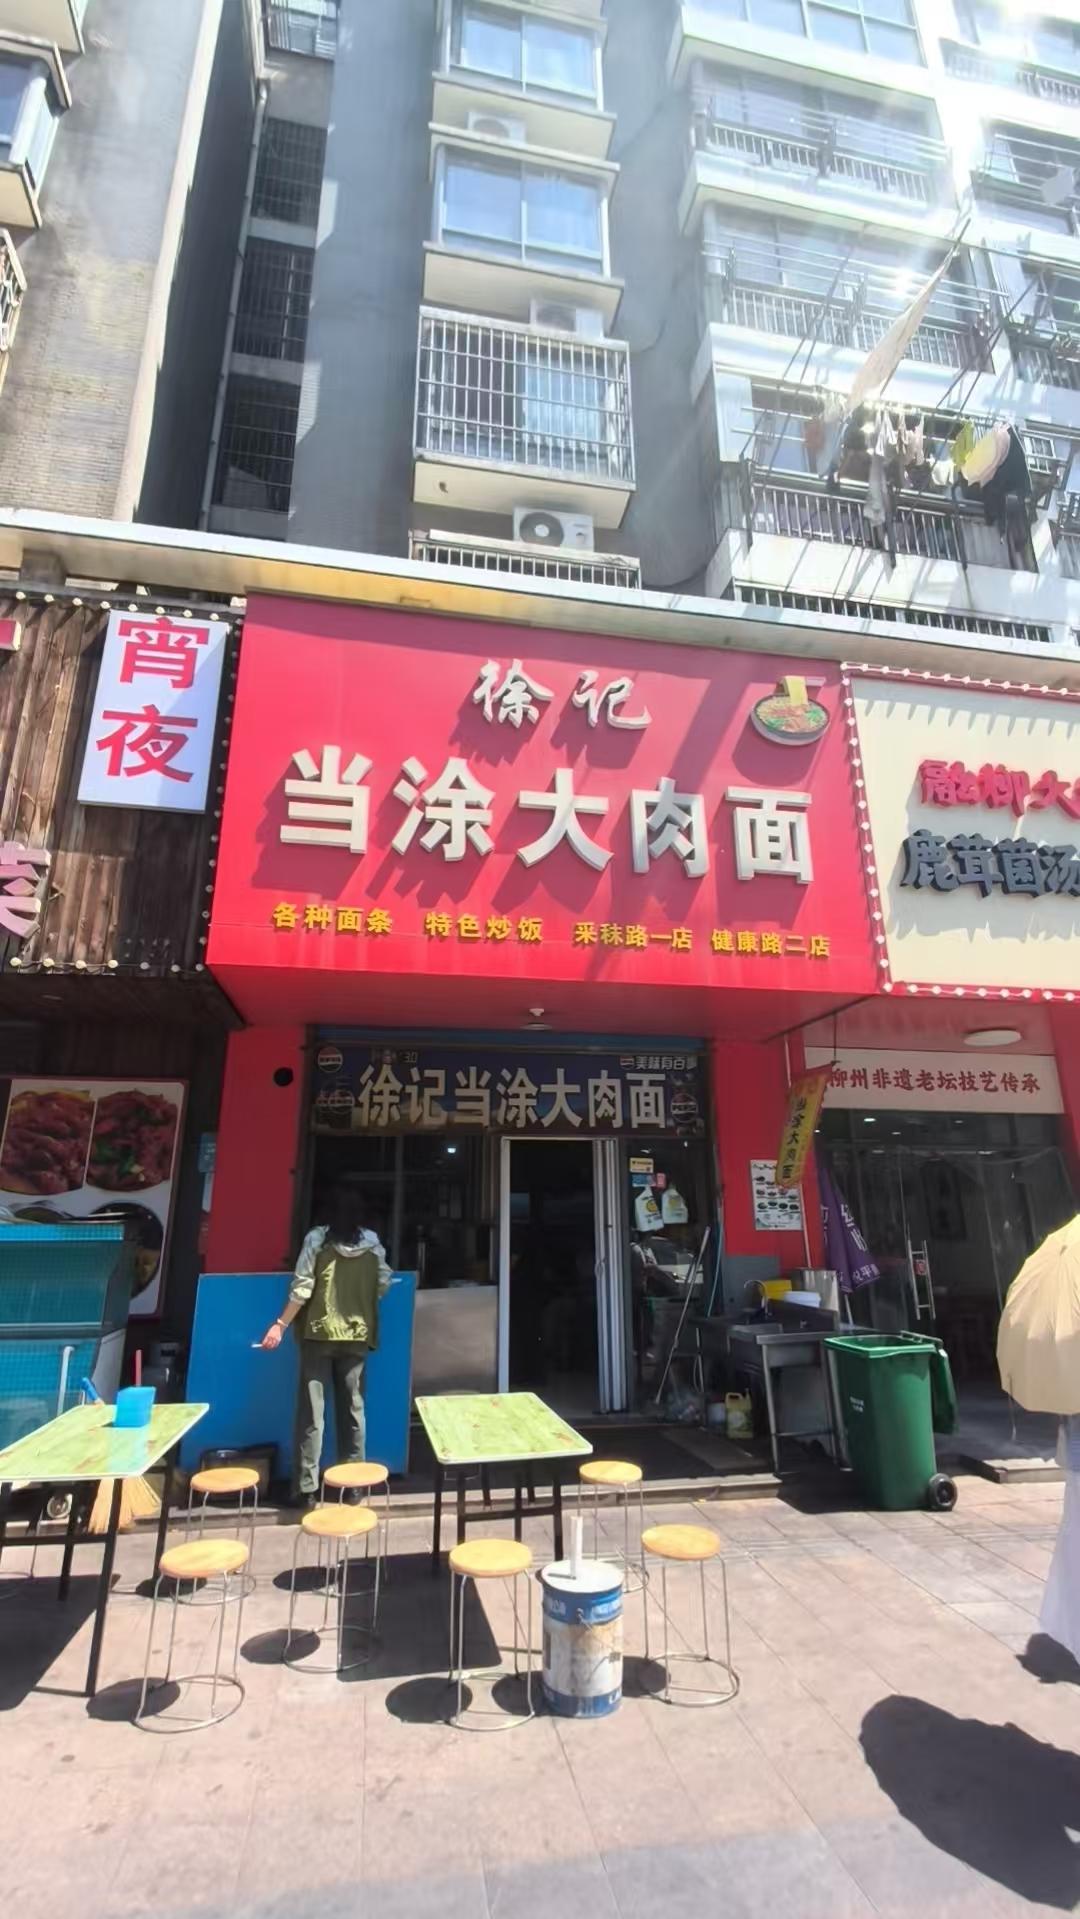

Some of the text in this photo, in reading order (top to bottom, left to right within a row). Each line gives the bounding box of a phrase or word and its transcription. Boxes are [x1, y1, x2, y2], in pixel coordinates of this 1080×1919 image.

[96, 616, 209, 783] 宵夜
[472, 658, 652, 730] 徐记
[280, 745, 815, 884] 当涂大肉面
[919, 759, 1080, 820] 融柳大
[273, 901, 393, 934] 各种面条
[425, 911, 543, 942] 特色炒饭
[711, 928, 831, 957] 健康路二店
[358, 1064, 666, 1129] 徐记当涂大肉面
[829, 1067, 1041, 1095] 柳州非遗老坛技艺传承
